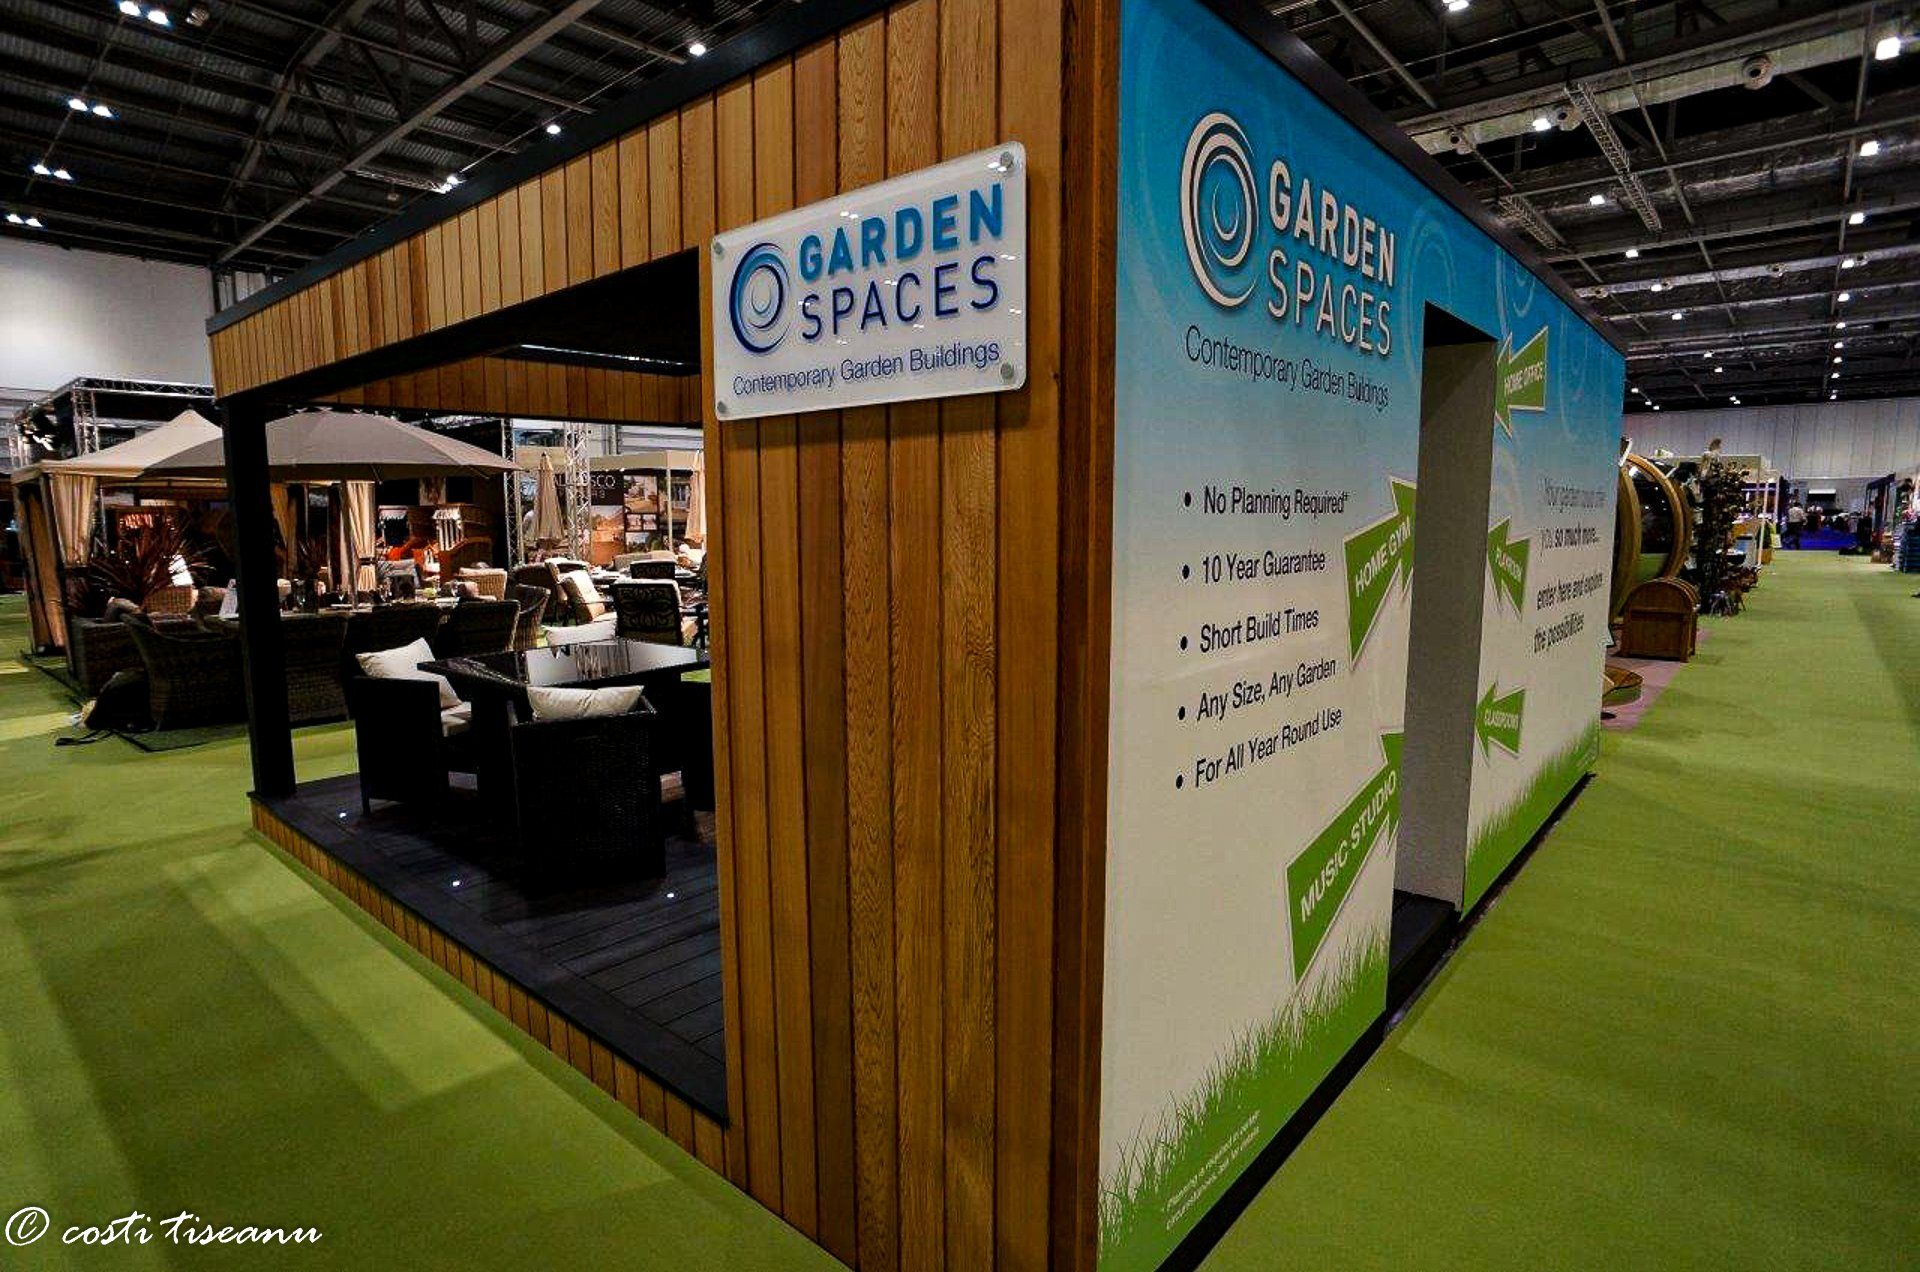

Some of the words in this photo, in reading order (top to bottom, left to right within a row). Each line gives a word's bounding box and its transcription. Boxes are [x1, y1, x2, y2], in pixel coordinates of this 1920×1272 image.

[799, 183, 1003, 282] GARDEN
[1269, 160, 1394, 287] GARDEN
[801, 256, 998, 340] SPACES
[1268, 250, 1391, 355] SPACES
[733, 366, 835, 395] Contemporary
[841, 356, 902, 380] Garden
[910, 343, 1000, 373] Buildings
[1186, 325, 1297, 391] Contemporary
[1302, 359, 1344, 395] Garden
[1349, 372, 1389, 411] Buildings
[1203, 486, 1226, 514] No
[1231, 487, 1290, 519] Planning
[1202, 556, 1221, 584] 10
[1226, 554, 1260, 582] Year
[1264, 550, 1325, 576] Guarantee
[1355, 542, 1388, 597] HOME
[1388, 514, 1411, 556] GYM
[1200, 621, 1242, 653] Short
[1246, 612, 1280, 643] Build
[1284, 607, 1318, 632] Times
[1197, 692, 1228, 721] Any
[1232, 681, 1266, 709] Size,
[1269, 673, 1294, 698] Any
[1296, 659, 1336, 688] Garden
[1195, 758, 1222, 788] For
[1225, 747, 1244, 775] All
[1248, 733, 1278, 762] Year
[1282, 717, 1319, 748] Round
[1322, 708, 1342, 730] Use
[1301, 840, 1349, 923] MUSIC
[1350, 770, 1396, 850] STUDIO
